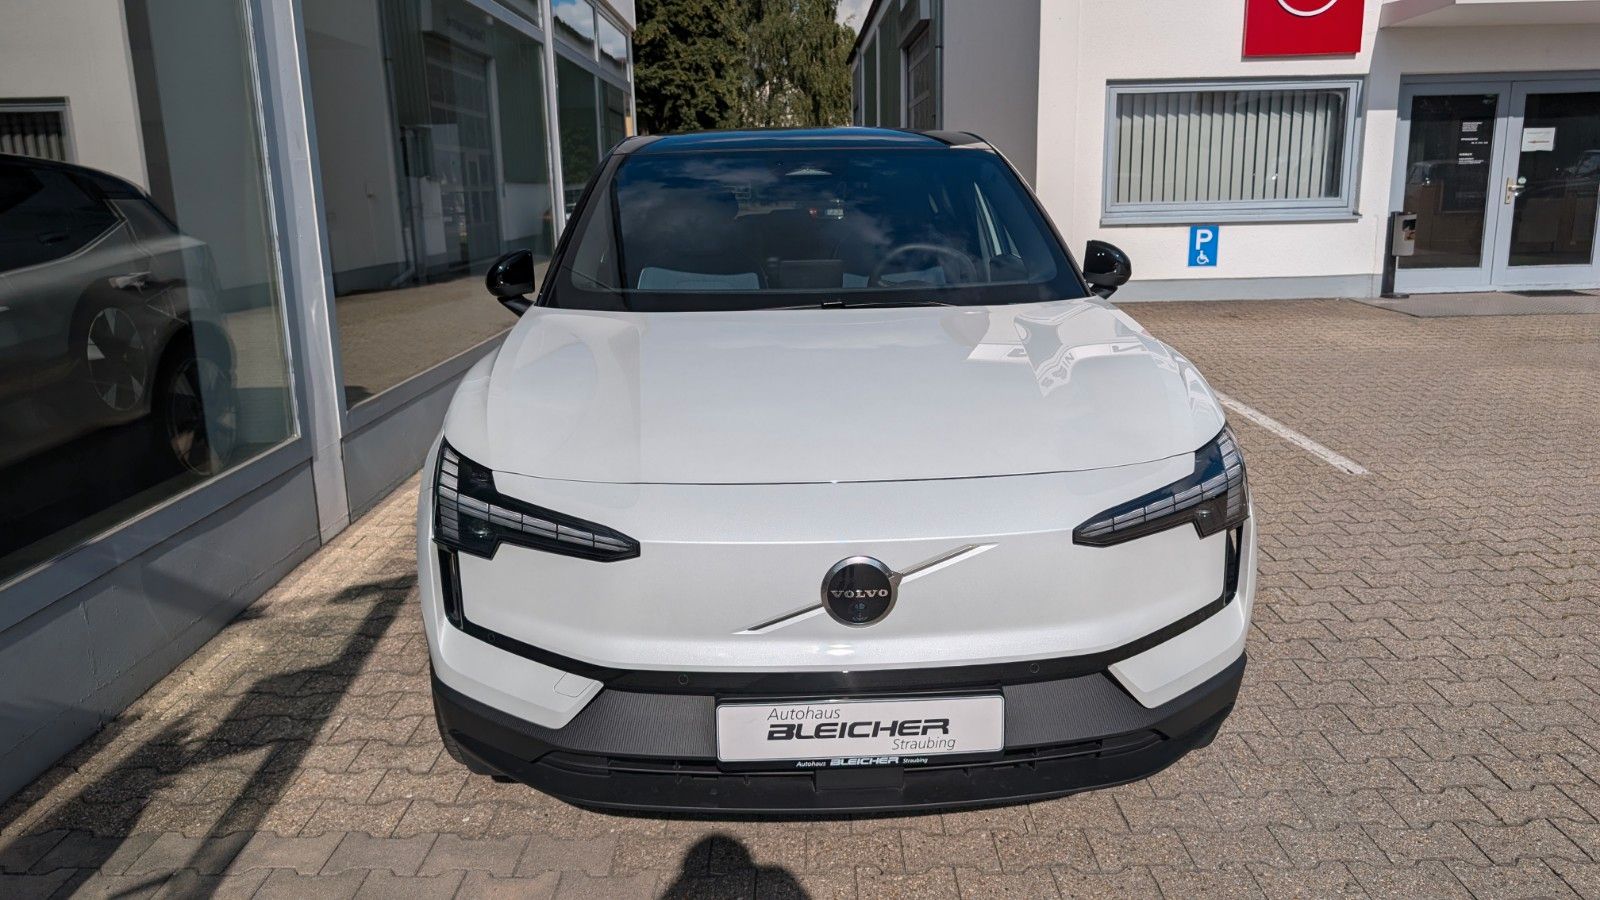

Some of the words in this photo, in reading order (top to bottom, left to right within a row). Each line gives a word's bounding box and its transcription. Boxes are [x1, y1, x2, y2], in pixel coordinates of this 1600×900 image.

[1195, 229, 1213, 250] P
[831, 589, 888, 598] VOLVO
[767, 706, 841, 721] Autohaus
[767, 718, 949, 740] BLEICHER
[891, 737, 956, 751] Straubing
[830, 757, 899, 766] BLEICHER
